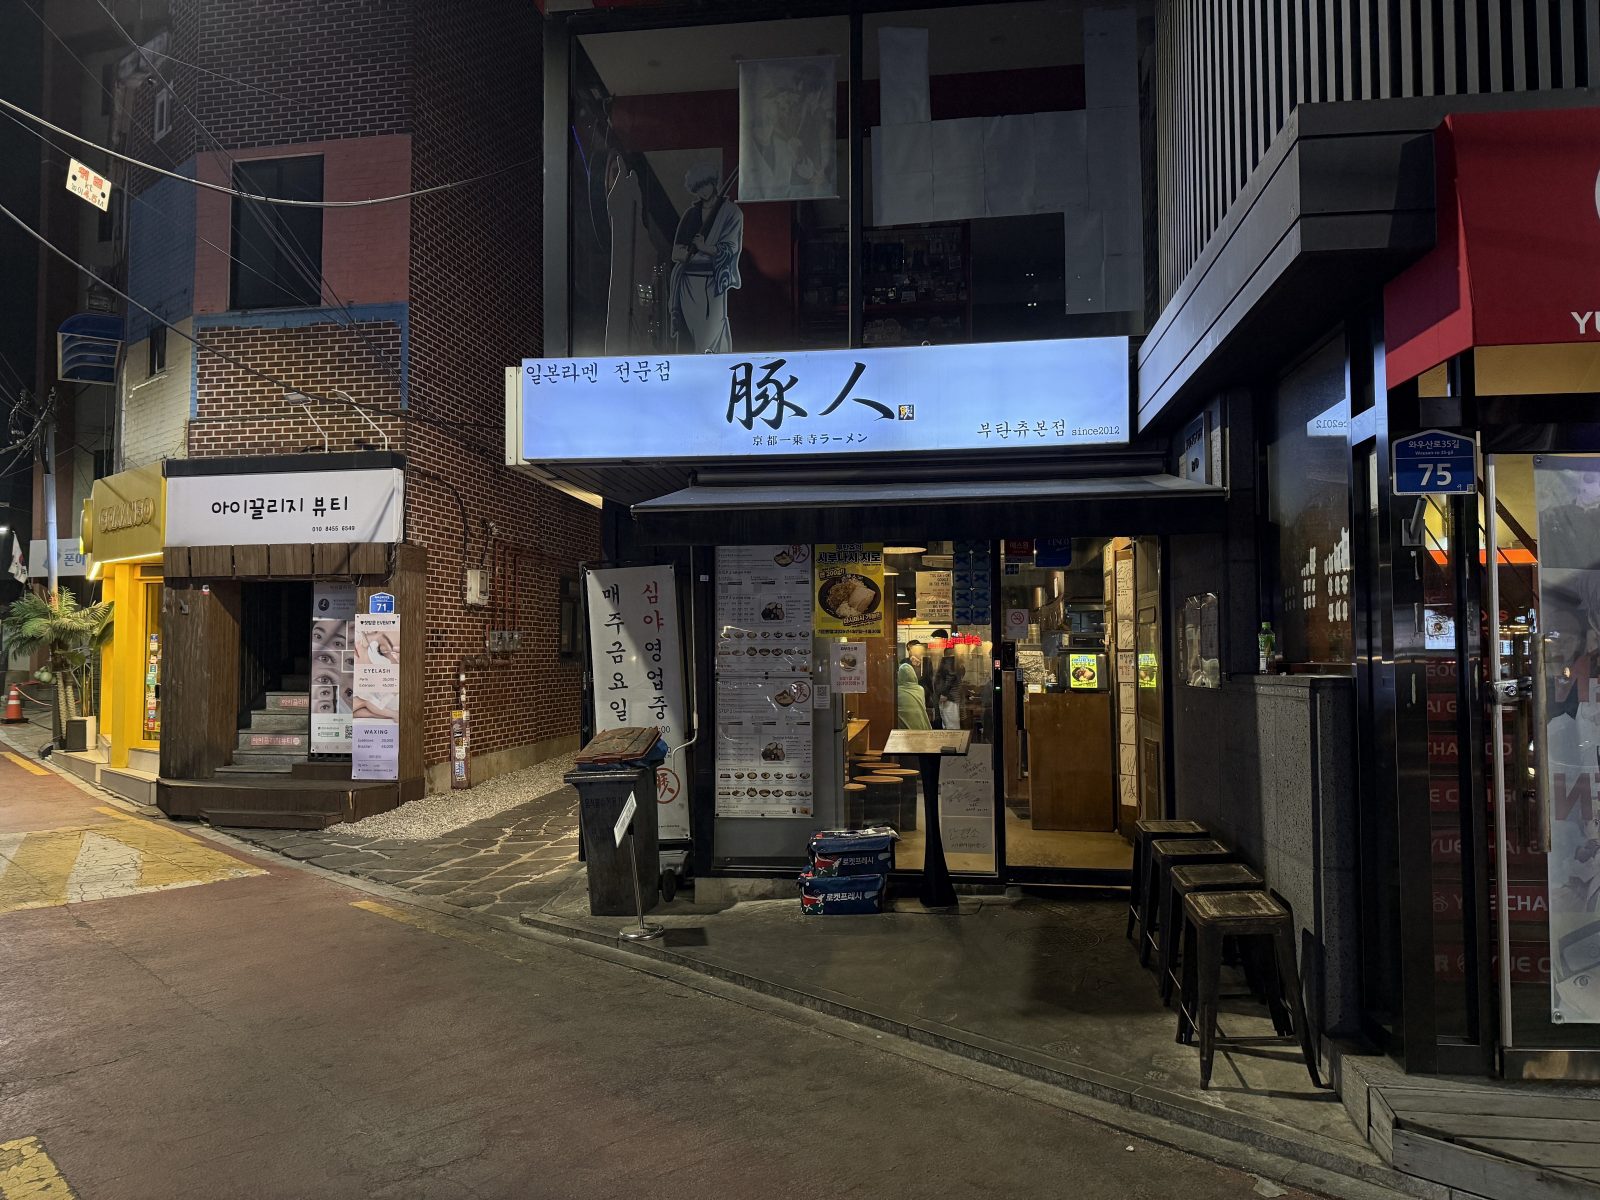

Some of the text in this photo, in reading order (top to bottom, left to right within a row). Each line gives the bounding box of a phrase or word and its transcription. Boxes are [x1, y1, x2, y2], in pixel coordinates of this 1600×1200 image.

[1571, 311, 1600, 334] Y
[526, 360, 671, 384] 일본라멘 전문점
[726, 358, 895, 431] 豚人
[976, 418, 1120, 439] 부탄츄본점 since2012
[1408, 440, 1460, 449] 와우산로35길
[1418, 463, 1452, 486] 75
[211, 495, 348, 520] 아이끌리지 뷰티
[376, 603, 387, 611] 71
[842, 857, 874, 866] 로켓프레시
[825, 892, 863, 901] 로켓프레시
